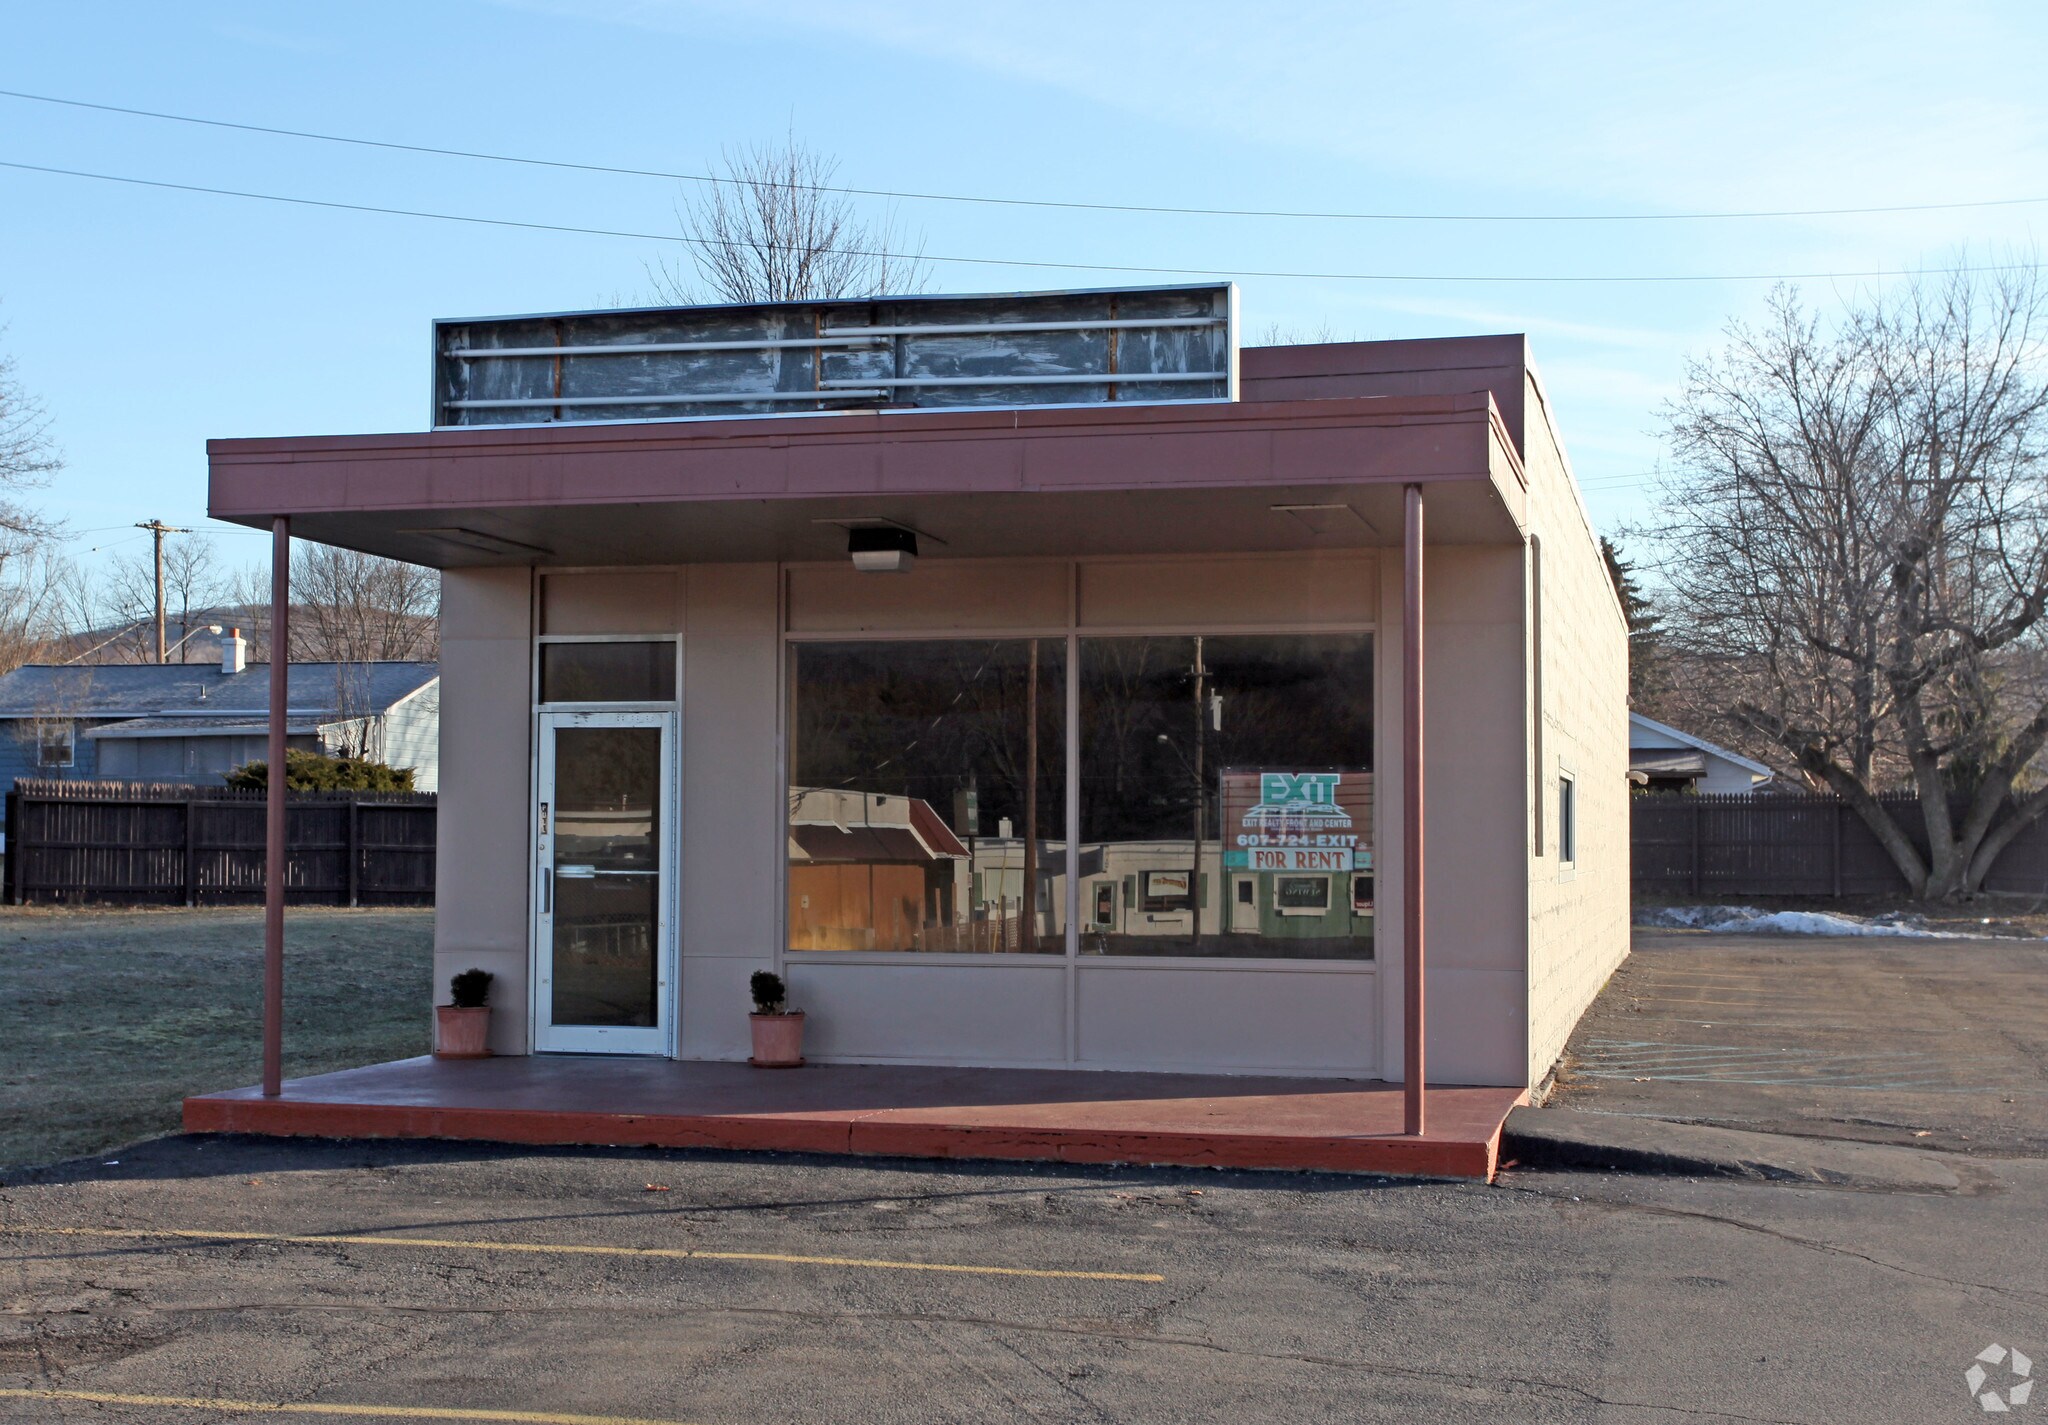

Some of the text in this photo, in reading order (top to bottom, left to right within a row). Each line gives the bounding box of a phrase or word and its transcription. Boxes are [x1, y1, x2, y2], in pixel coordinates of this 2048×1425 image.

[1242, 818, 1352, 828] EXIT REALTY FRONT AND CENTER
[1236, 834, 1358, 847] 607-724-EXIT
[1255, 851, 1345, 869] FOR RENT
